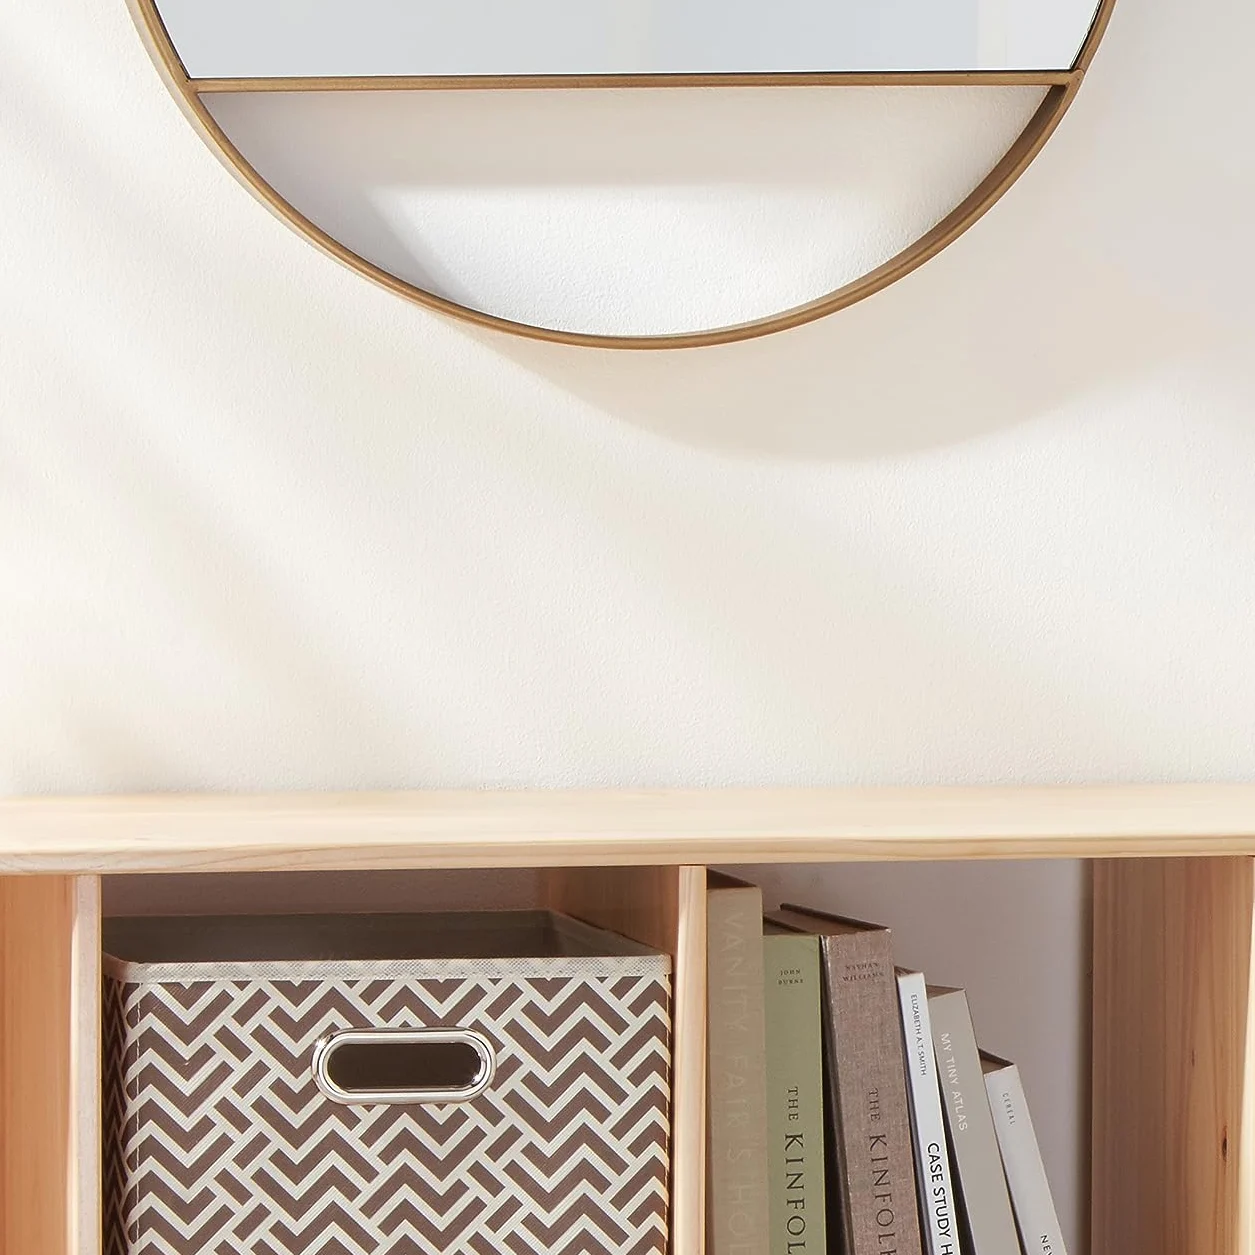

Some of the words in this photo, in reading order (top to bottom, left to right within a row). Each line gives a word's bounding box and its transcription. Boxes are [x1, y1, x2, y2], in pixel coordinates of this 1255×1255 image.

[721, 911, 749, 1033] VANITY
[911, 994, 921, 1035] ELIZABETH
[918, 1051, 927, 1076] SMITH
[941, 1033, 952, 1051] MY
[946, 1057, 959, 1084] TINY
[787, 1086, 799, 1121] THE
[868, 1087, 881, 1122] THE
[952, 1091, 968, 1131] ATLAS
[1002, 1092, 1015, 1125] CEREAL
[927, 1142, 943, 1182] CASE
[933, 1187, 951, 1238] STUDY
